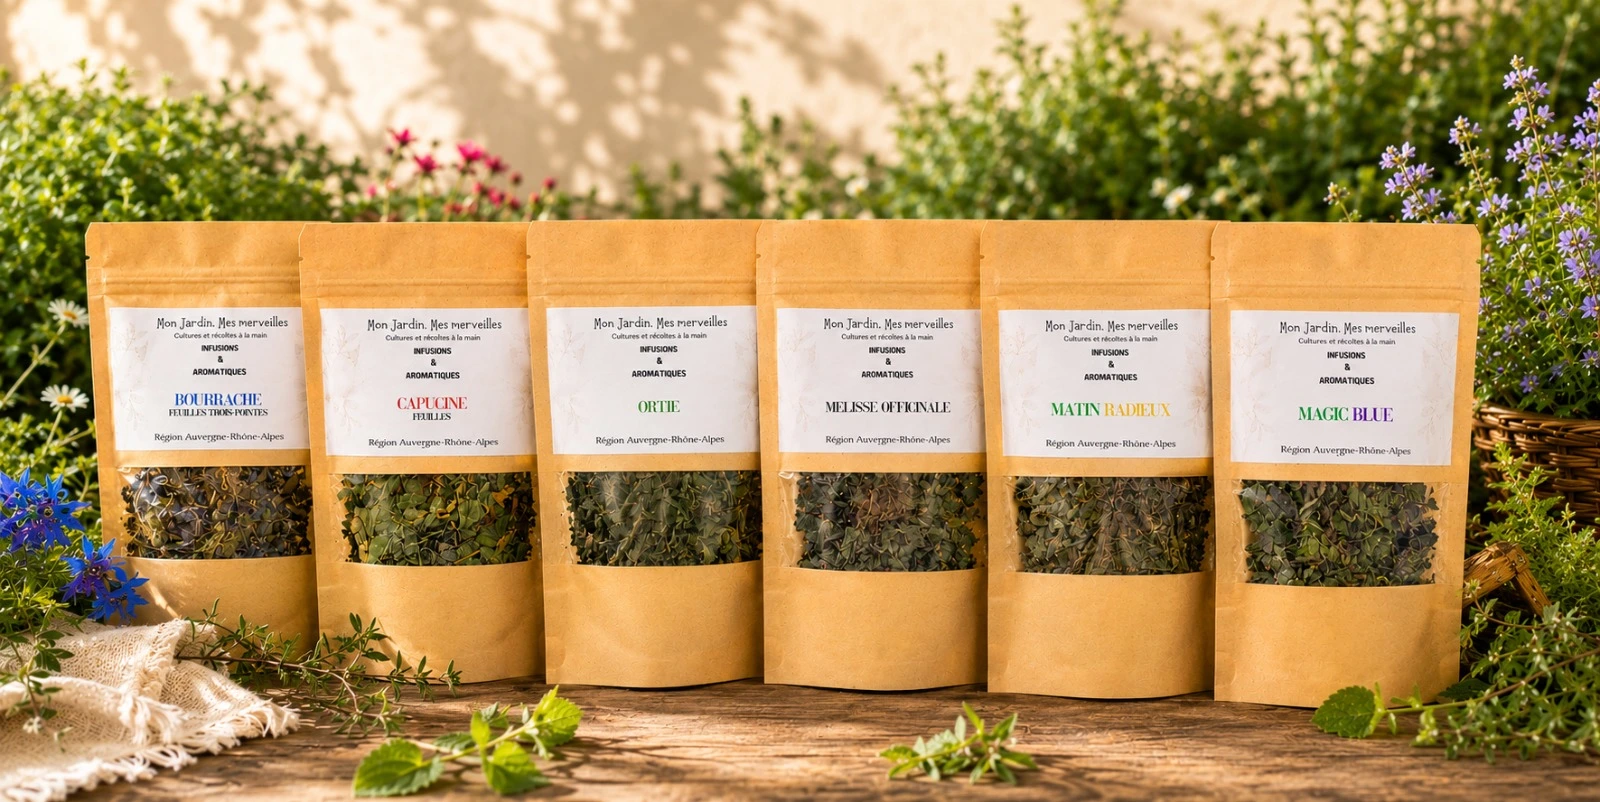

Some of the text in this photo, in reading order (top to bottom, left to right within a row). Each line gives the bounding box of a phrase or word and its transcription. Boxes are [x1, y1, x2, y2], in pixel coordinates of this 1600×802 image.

[157, 316, 288, 330] Mon Jardin. Mes merveilles
[368, 317, 502, 332] Mon Jardin. Mes merveilles
[594, 315, 727, 330] Mon Jardin. Mes merveilles
[824, 317, 953, 331] Mon Jardin. Mes merveilles
[1046, 318, 1178, 333] Mon Jardin. Mes merveilles
[1280, 321, 1416, 335] Mon Jardin. Mes merveilles
[201, 344, 239, 352] INFUSIONS
[414, 347, 452, 355] INFUSIONS
[640, 345, 678, 353] INFUSIONS
[1327, 351, 1366, 359] INFUSIONS
[431, 358, 437, 366] &
[1108, 360, 1114, 368] &
[1344, 363, 1350, 371] &
[192, 368, 246, 376] AROMATIQUES
[406, 372, 460, 380] AROMATIQUES
[632, 370, 686, 378] AROMATIQUES
[861, 371, 913, 379] AROMATIQUES
[1084, 374, 1138, 382] AROMATIQUES
[1319, 377, 1375, 385] AROMATIQUES
[175, 393, 262, 406] BOURRACHE
[397, 397, 467, 409] CAPUCINE
[638, 400, 680, 413] ORTIE
[826, 401, 951, 413] MELISSE OFFICINALE
[1051, 403, 1170, 417] MATIN RADIEUX
[208, 408, 268, 416] TROIS-POINTES
[1298, 407, 1393, 422] MAGIC BLUE
[155, 433, 183, 443] Région
[596, 437, 624, 446] Région
[826, 436, 854, 445] Région
[369, 439, 397, 448] Région
[1046, 439, 1075, 449] Région
[1281, 445, 1310, 455] Région
